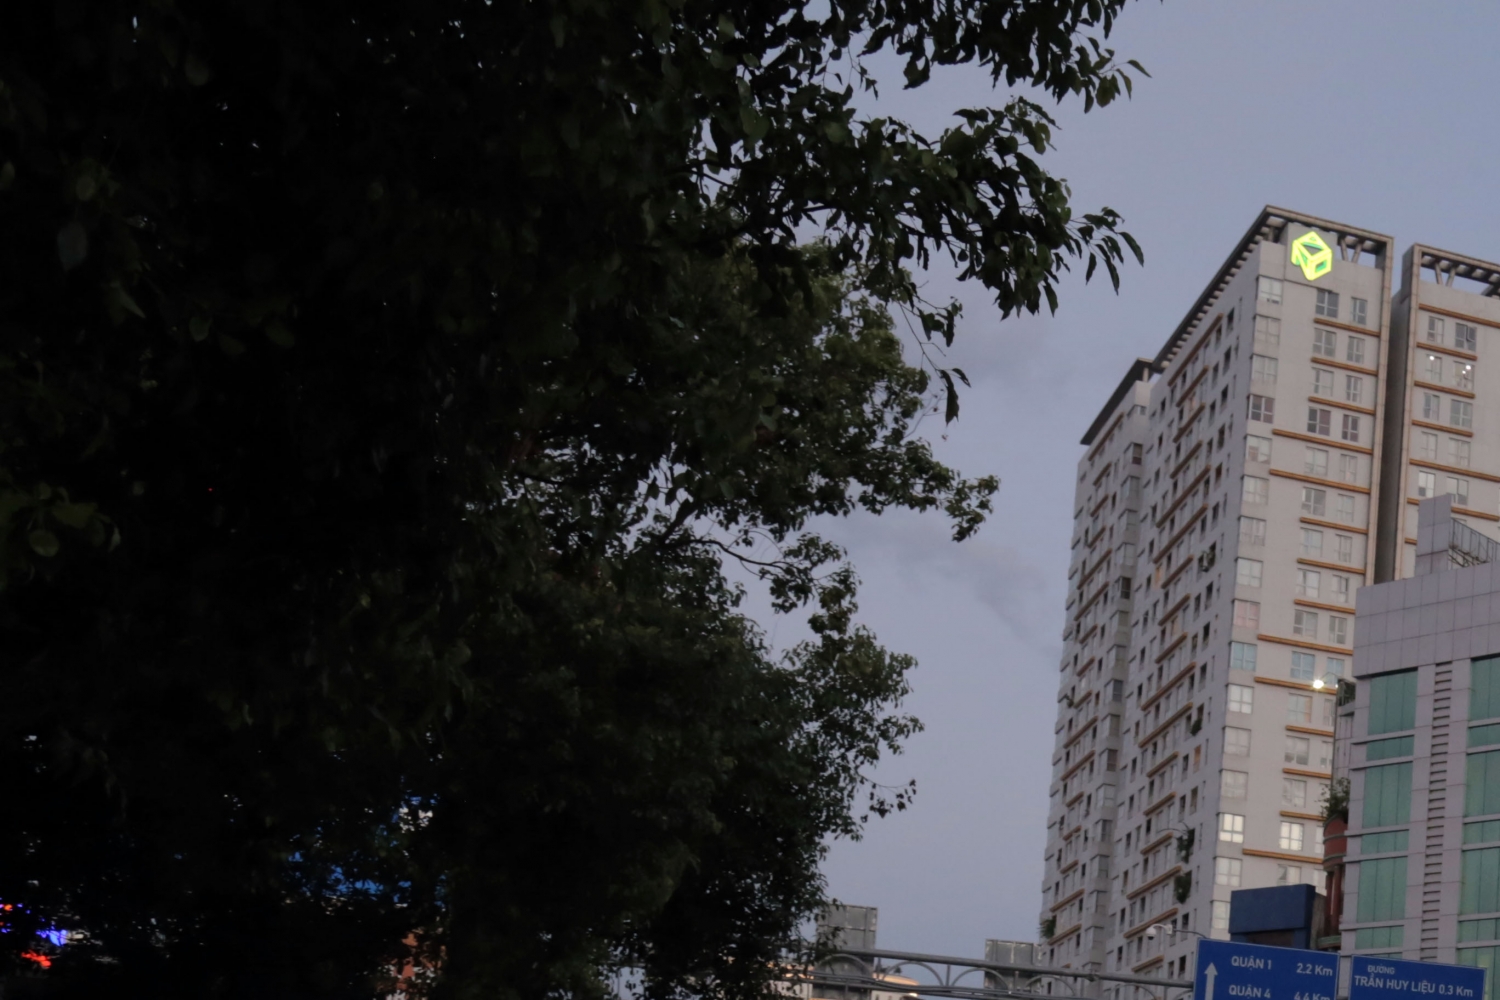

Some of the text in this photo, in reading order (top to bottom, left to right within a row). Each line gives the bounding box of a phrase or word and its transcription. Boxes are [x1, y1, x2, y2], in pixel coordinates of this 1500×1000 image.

[1231, 955, 1333, 977] QUẬN 1 2.2 Km
[1228, 984, 1262, 999] QUẬN
[1263, 988, 1271, 999] 4
[1386, 978, 1409, 990] HUY
[1411, 980, 1435, 995] LIỆU
[1438, 984, 1453, 996] 0.3
[1456, 986, 1473, 997] Km
